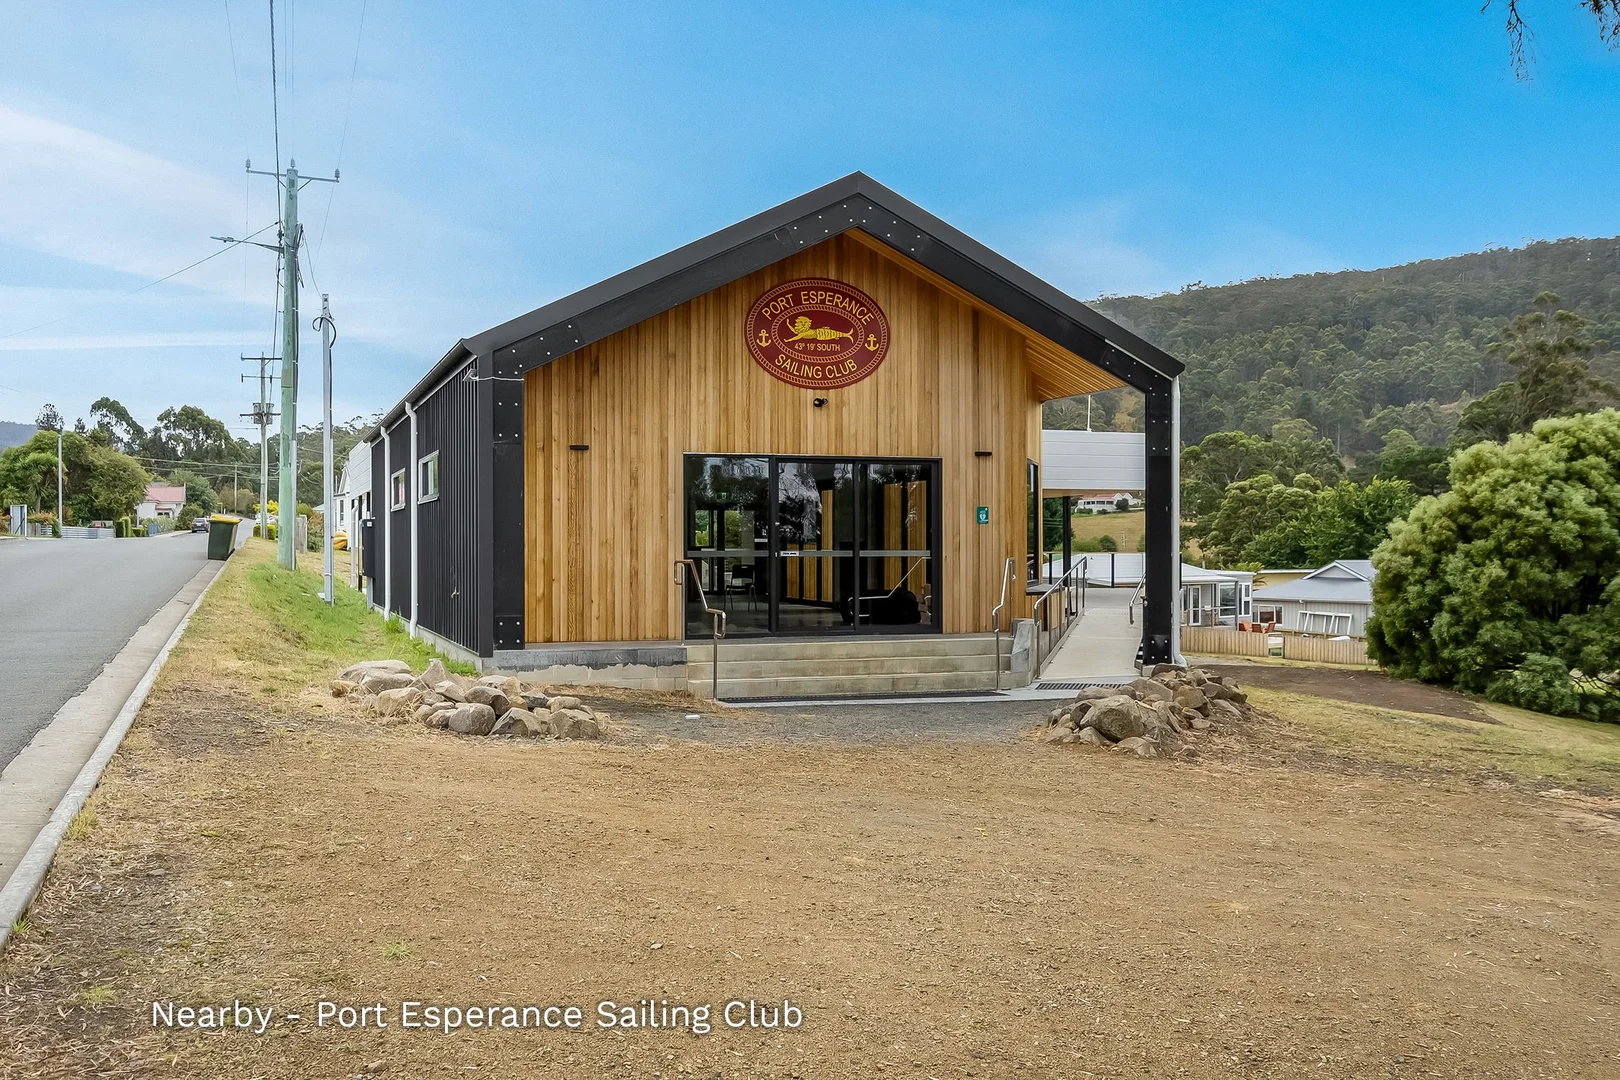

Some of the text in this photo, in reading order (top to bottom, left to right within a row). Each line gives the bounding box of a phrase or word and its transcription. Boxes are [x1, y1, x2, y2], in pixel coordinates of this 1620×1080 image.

[761, 290, 875, 326] PORT ESPERANCE
[816, 343, 841, 352] SOUTH
[774, 353, 858, 379] SAILING CLUB
